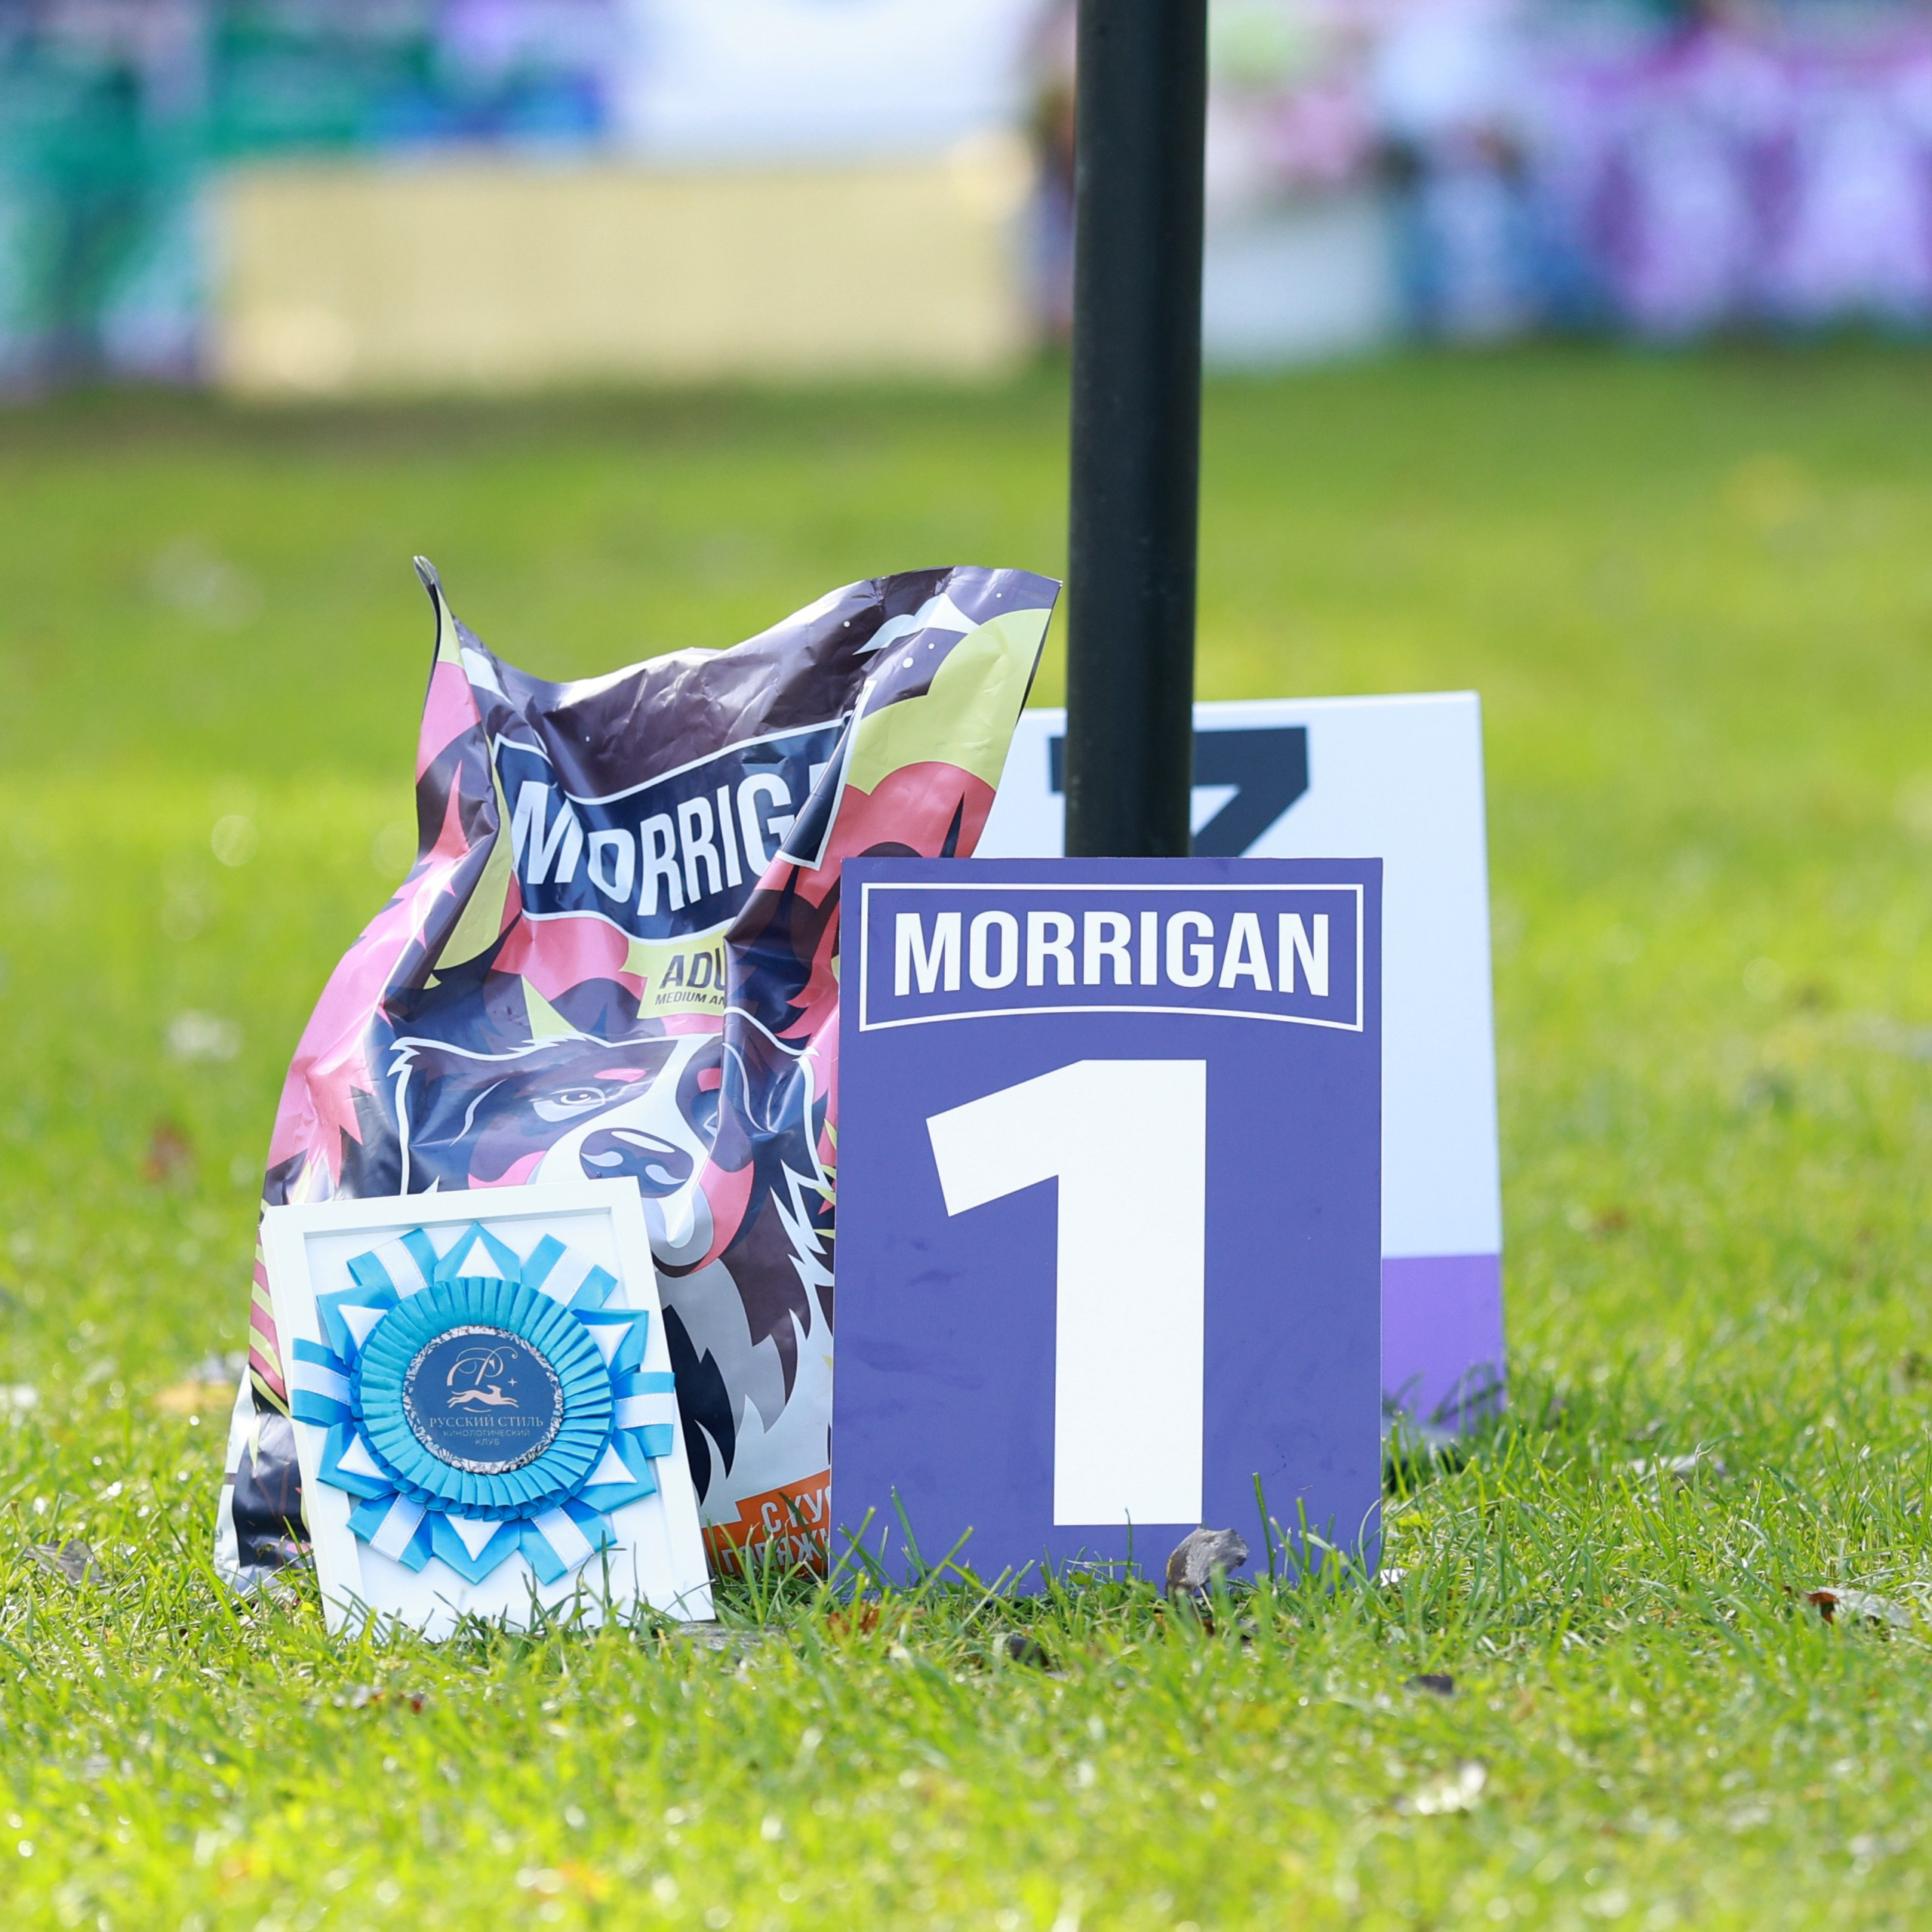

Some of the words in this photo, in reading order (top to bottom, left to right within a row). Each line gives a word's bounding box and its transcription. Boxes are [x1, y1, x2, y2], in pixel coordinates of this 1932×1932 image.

[512, 762, 829, 916] MORRIG
[894, 910, 1330, 996] MORRIGAN
[655, 991, 707, 1005] MEDIUM
[926, 1060, 1207, 1526] 1
[429, 1414, 494, 1428] РУССКИЙ
[497, 1417, 543, 1427] СТИЛЬ
[443, 1429, 531, 1437] КИНОЛОГИЧЕСКИЙ
[761, 1501, 783, 1533] С
[786, 1485, 831, 1527] КУ
